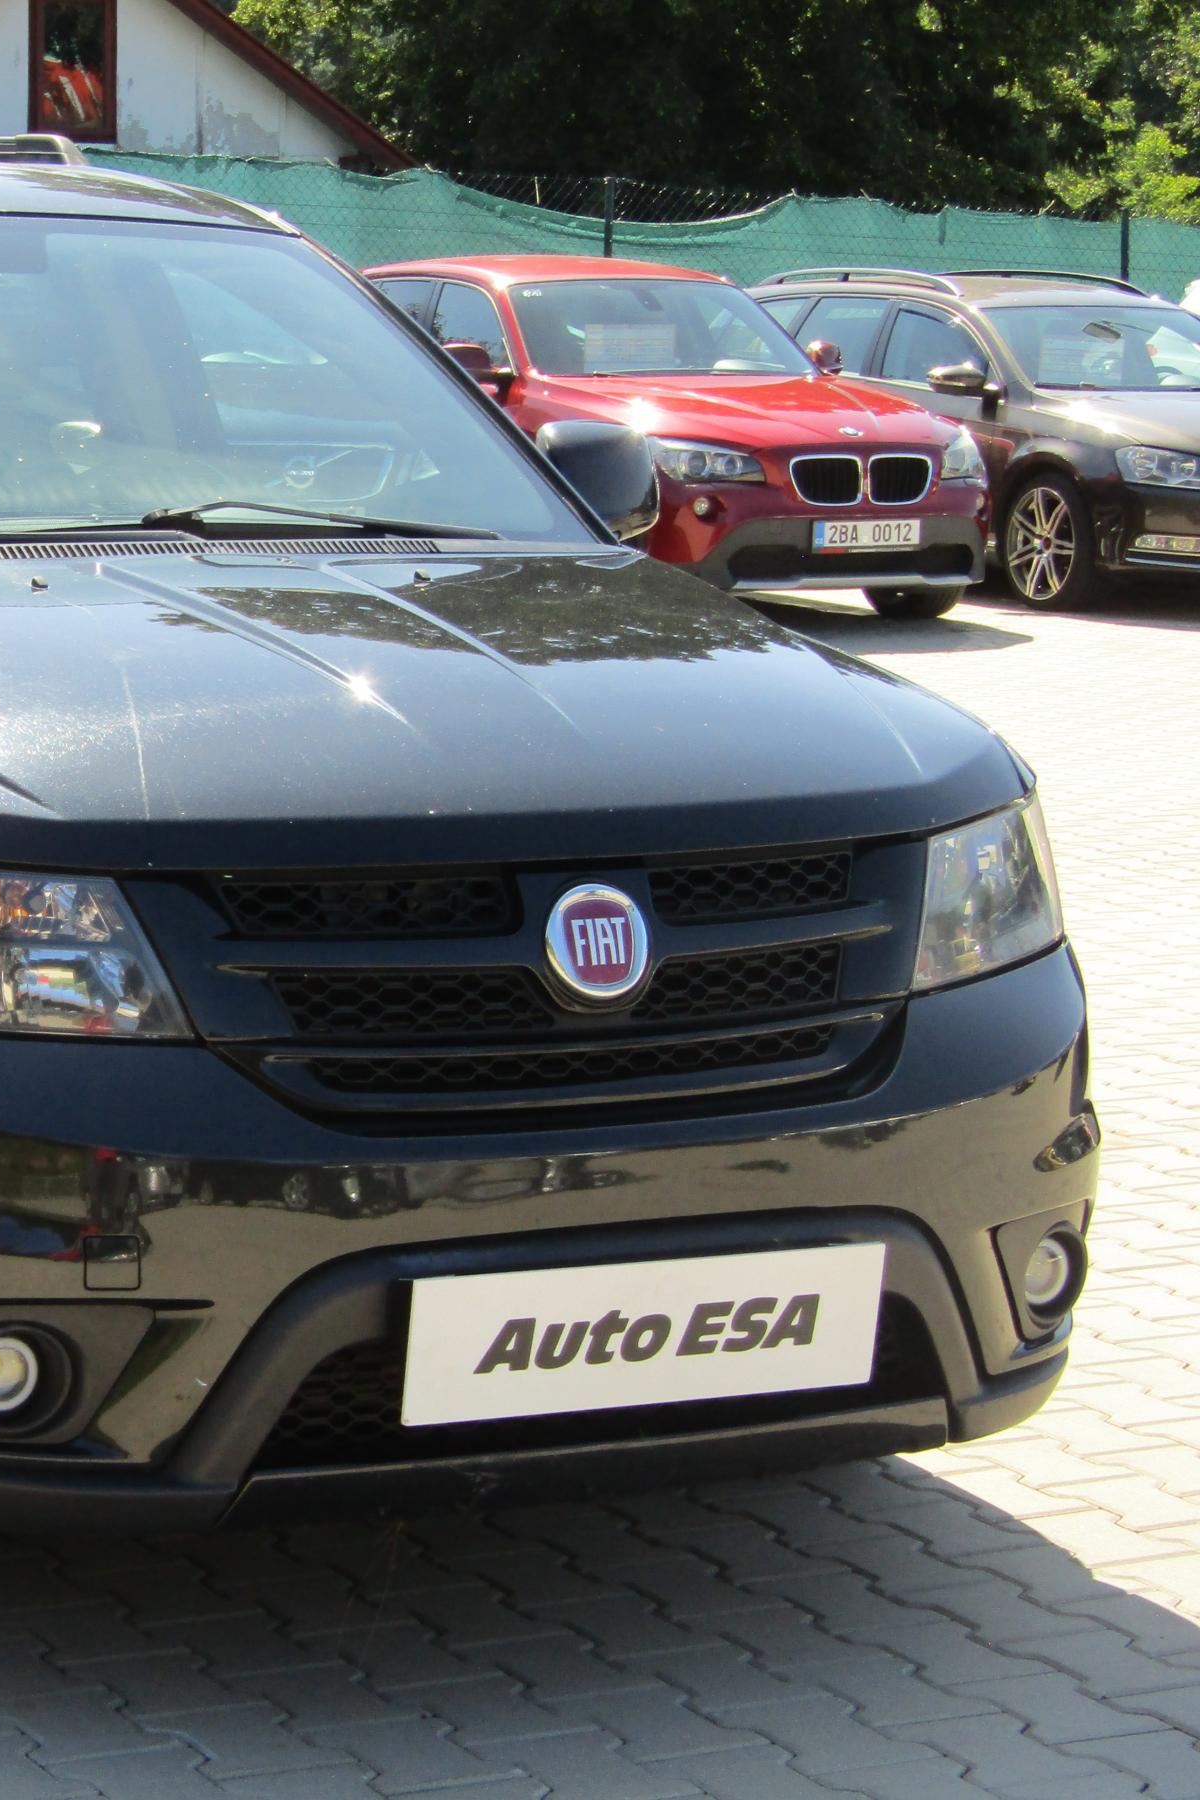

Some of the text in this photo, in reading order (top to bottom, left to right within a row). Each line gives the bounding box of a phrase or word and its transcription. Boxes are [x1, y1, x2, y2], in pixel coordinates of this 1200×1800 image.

[828, 524, 858, 544] 2BA
[872, 523, 912, 543] 0012
[571, 917, 625, 967] FIAT
[473, 1293, 821, 1375] Auto ESA
